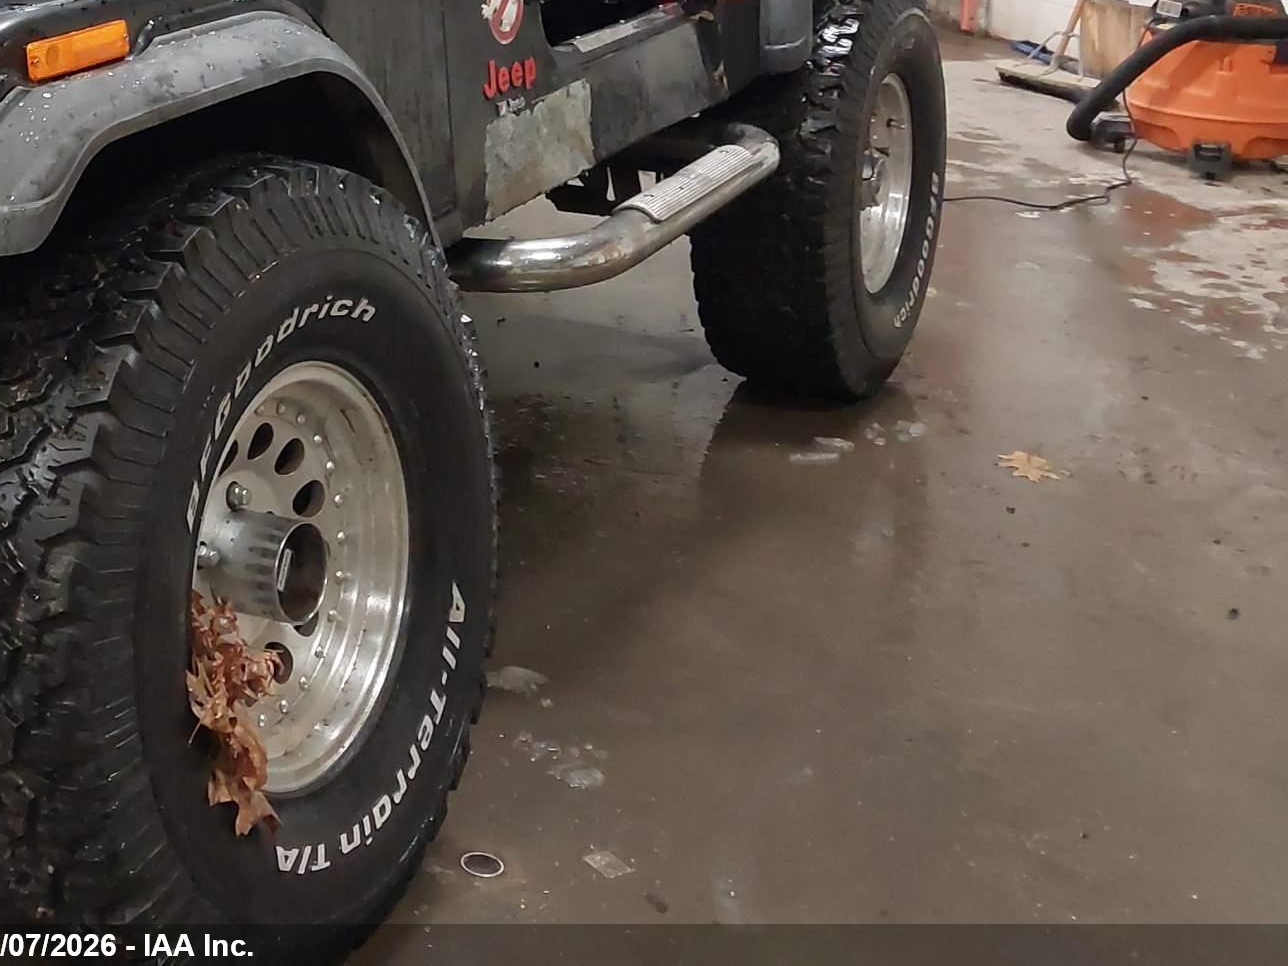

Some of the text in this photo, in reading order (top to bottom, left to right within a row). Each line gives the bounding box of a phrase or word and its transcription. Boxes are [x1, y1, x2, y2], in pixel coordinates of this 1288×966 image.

[482, 58, 537, 99] Jeep
[275, 580, 467, 874] All-Terrain T/A
